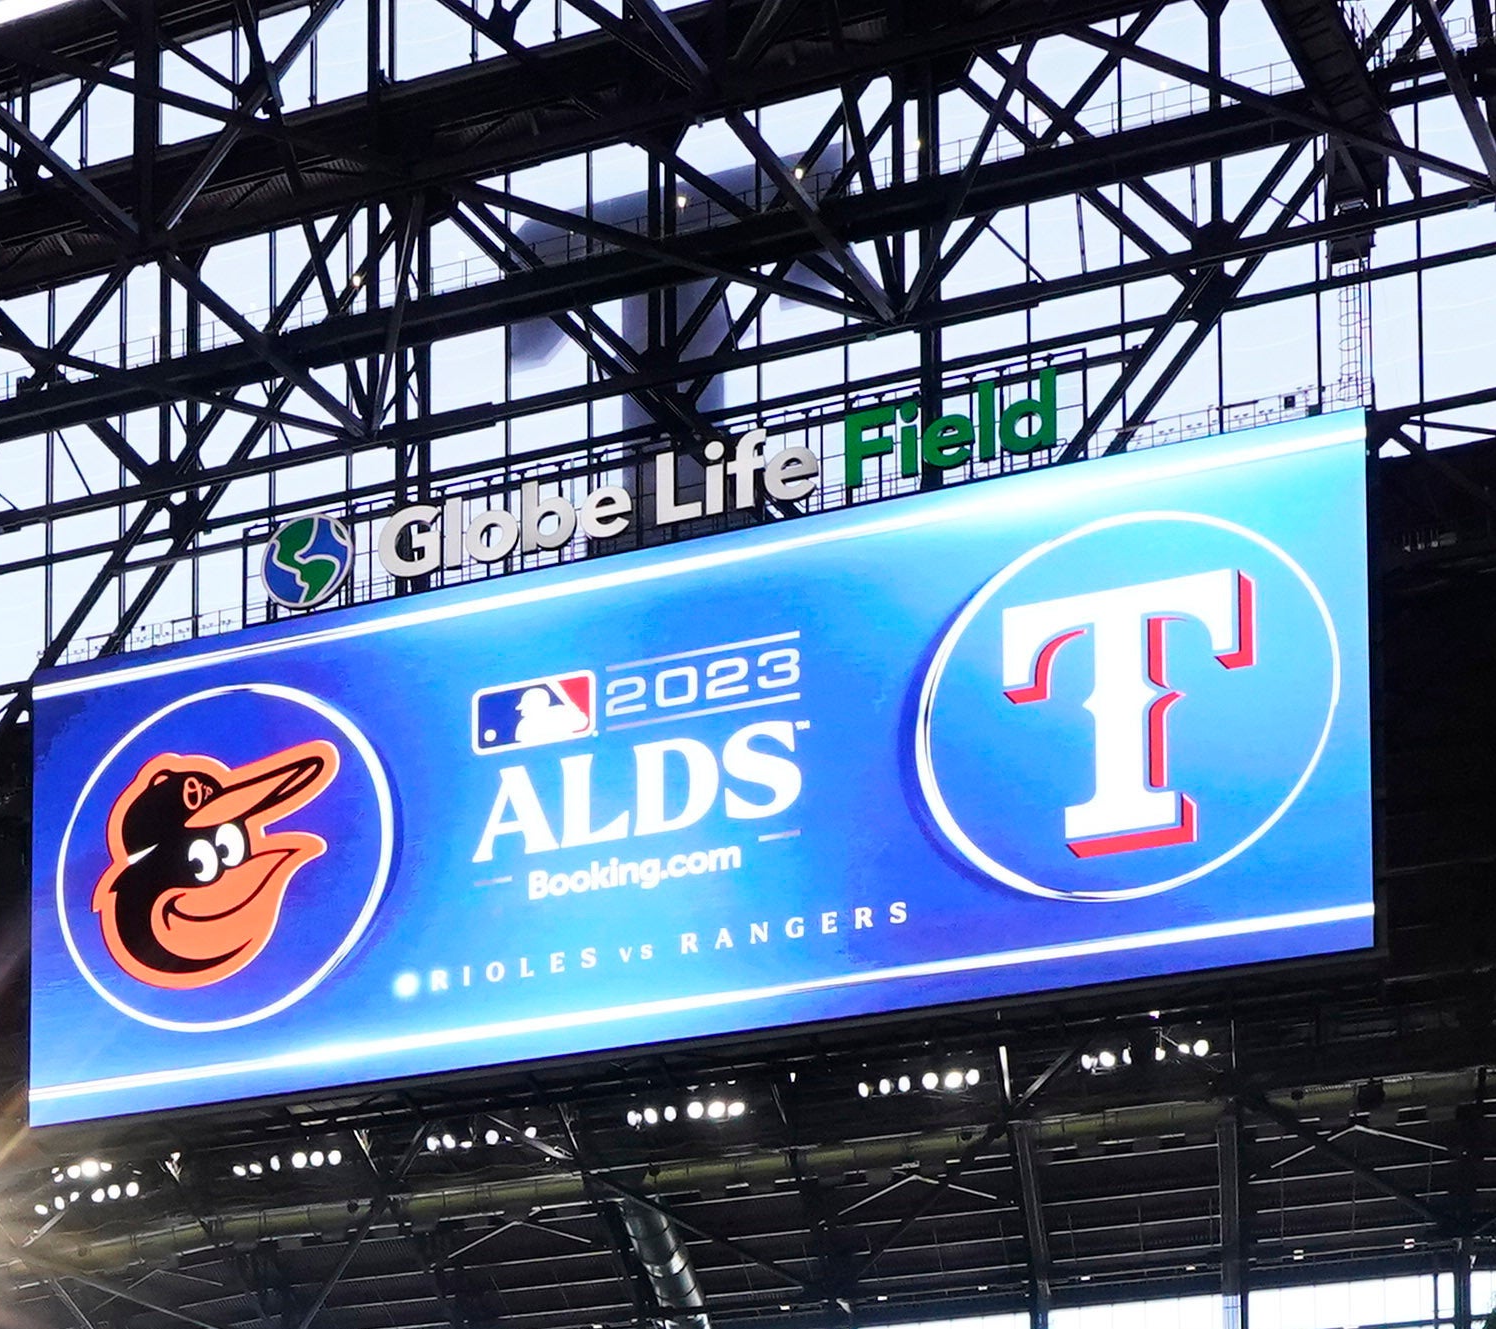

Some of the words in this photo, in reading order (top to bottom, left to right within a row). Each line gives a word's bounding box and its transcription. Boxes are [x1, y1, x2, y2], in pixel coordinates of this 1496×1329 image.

[377, 484, 632, 579] Globe
[654, 427, 819, 526] Life
[844, 367, 1058, 489] Field
[606, 648, 801, 717] 2023
[1002, 569, 1257, 860] T
[472, 720, 803, 863] ALDS
[528, 845, 741, 900] Booking.com
[393, 946, 598, 1000] RIOLES
[681, 901, 907, 955] RANGERS
